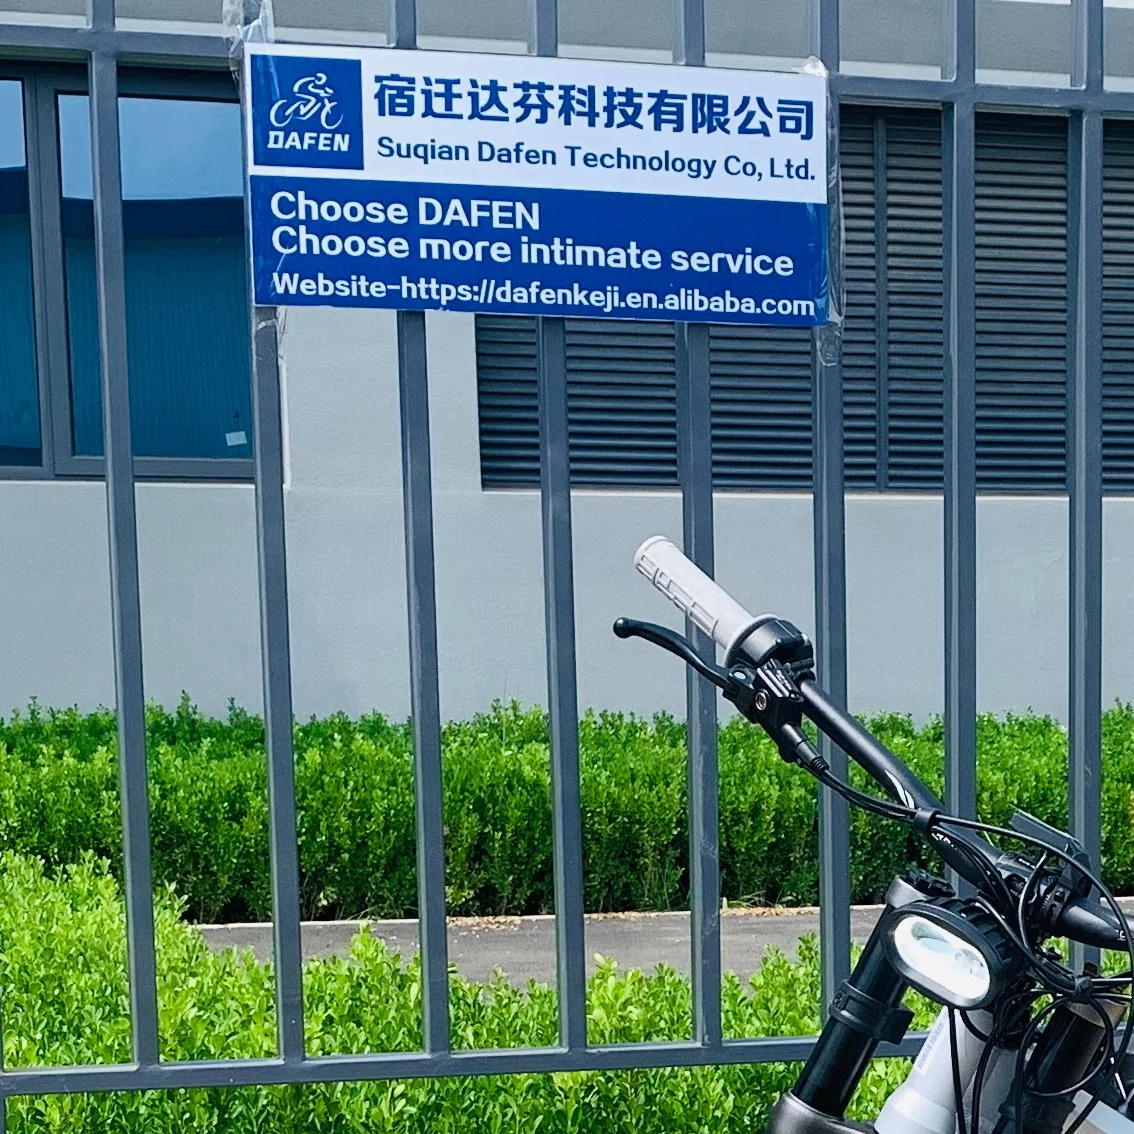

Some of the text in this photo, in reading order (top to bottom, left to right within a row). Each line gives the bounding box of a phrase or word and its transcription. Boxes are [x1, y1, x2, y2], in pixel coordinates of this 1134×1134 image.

[374, 73, 815, 141] 宿迁达芬科技有限公司
[267, 130, 350, 151] DAFEN
[377, 136, 470, 164] Suqian
[478, 141, 557, 165] Dafen
[564, 145, 717, 180] Technology
[770, 157, 816, 181] Ltd.
[270, 190, 540, 231] Choose DAFEN
[271, 225, 794, 277] Choose more intimate service
[272, 272, 815, 317] Website-https://dafenkeji.en.alibaba.com
